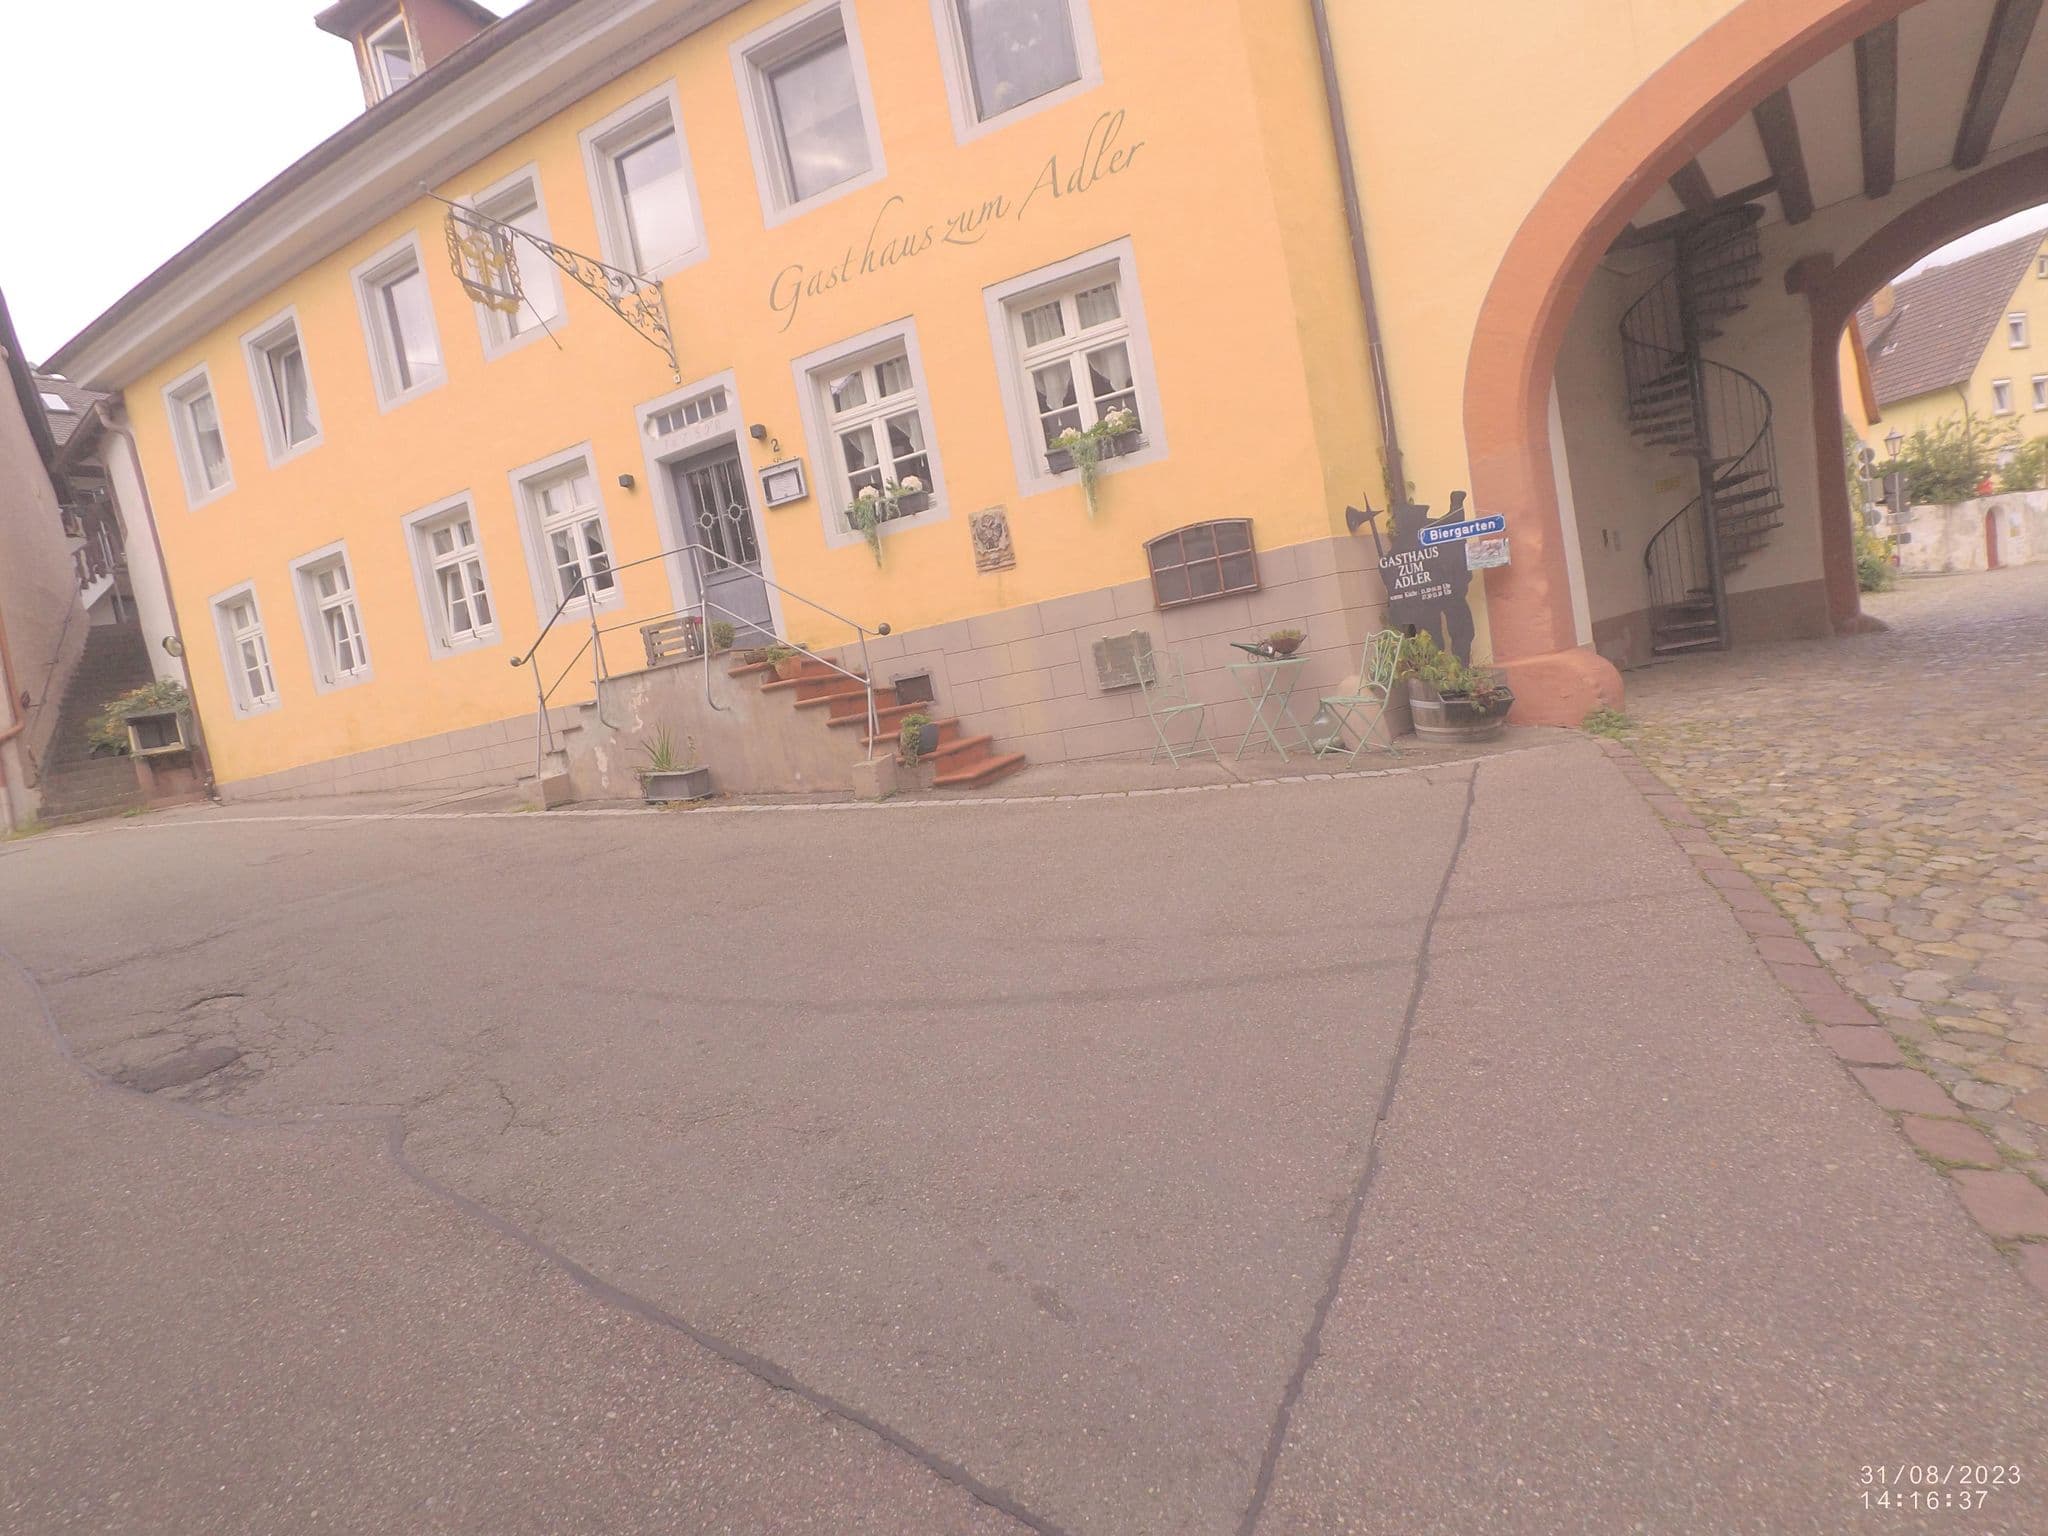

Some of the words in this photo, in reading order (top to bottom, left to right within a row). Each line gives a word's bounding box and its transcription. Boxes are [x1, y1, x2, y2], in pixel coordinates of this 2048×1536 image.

[769, 195, 933, 333] Gasthaus
[941, 194, 1012, 245] zum
[1017, 108, 1145, 222] Adler
[770, 438, 781, 453] 2
[1429, 519, 1496, 542] Biergarten
[1379, 546, 1440, 569] GASTHAUS
[1399, 562, 1424, 577] ZUM
[1394, 571, 1432, 590] ADLER
